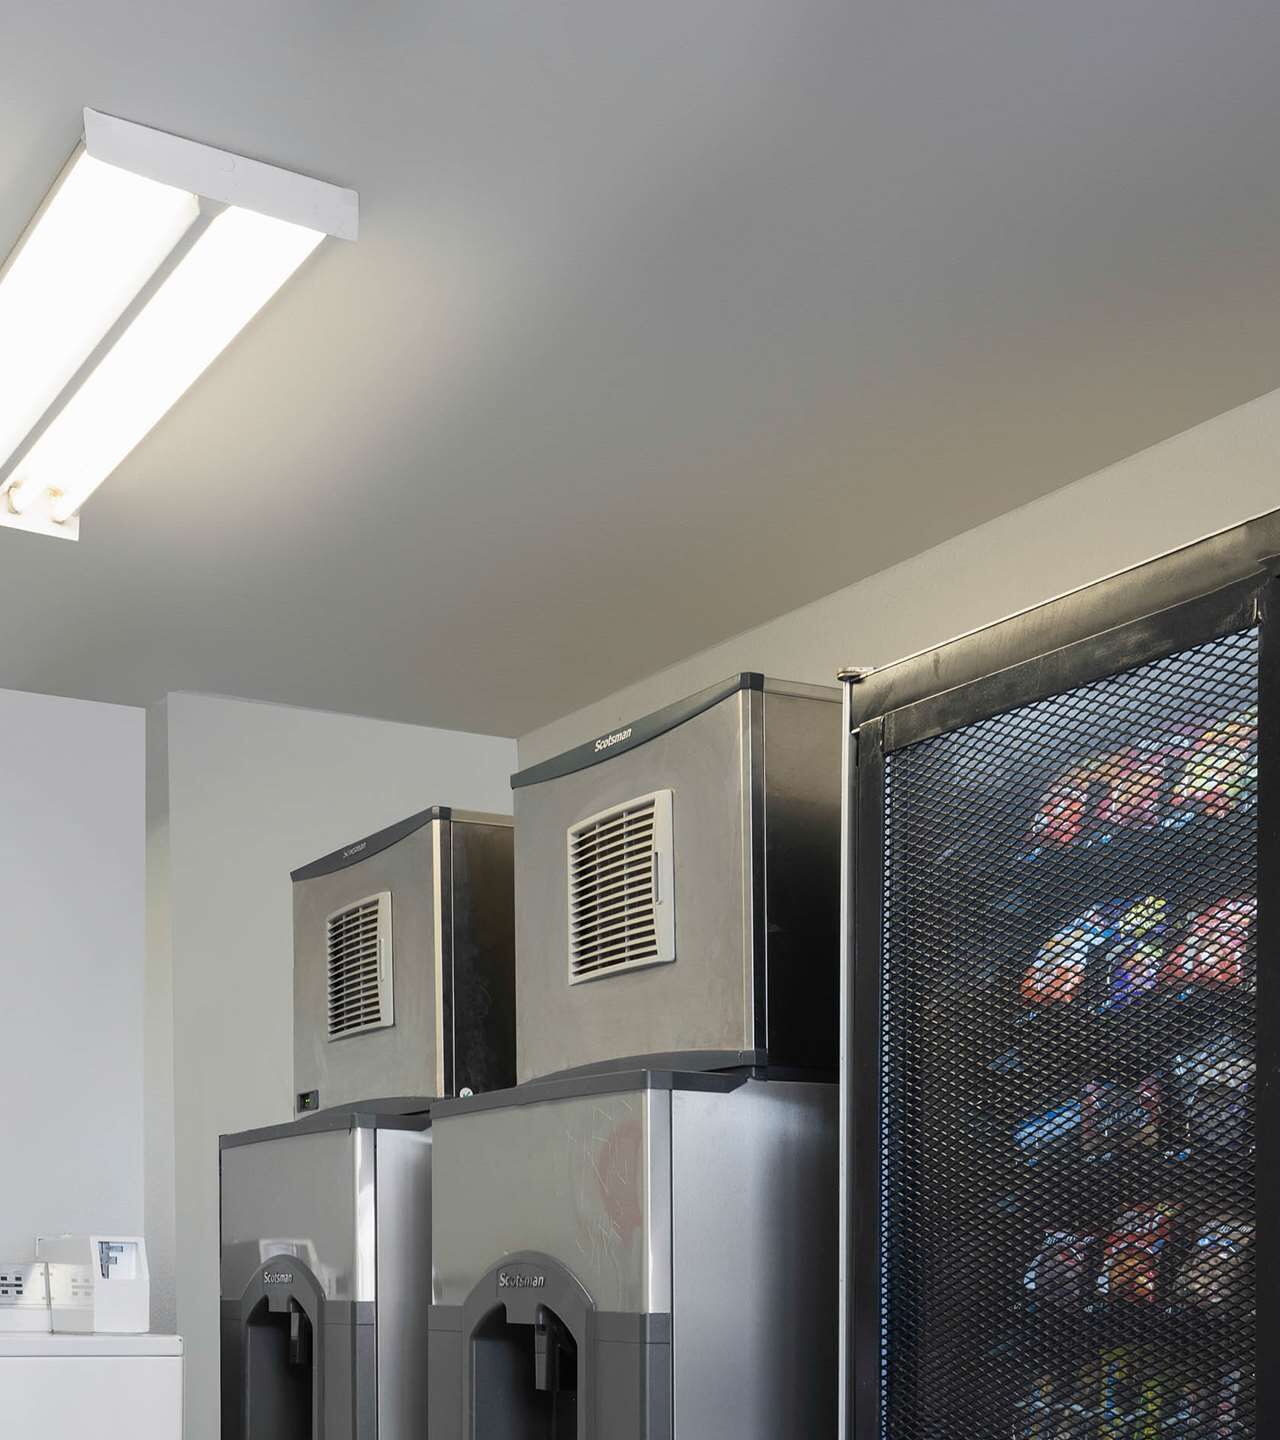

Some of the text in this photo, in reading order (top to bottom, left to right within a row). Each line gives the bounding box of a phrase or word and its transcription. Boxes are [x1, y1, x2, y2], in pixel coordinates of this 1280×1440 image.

[595, 728, 632, 752] Scotsman
[264, 1271, 294, 1283] Scotsman
[499, 1272, 544, 1287] Scotsman
